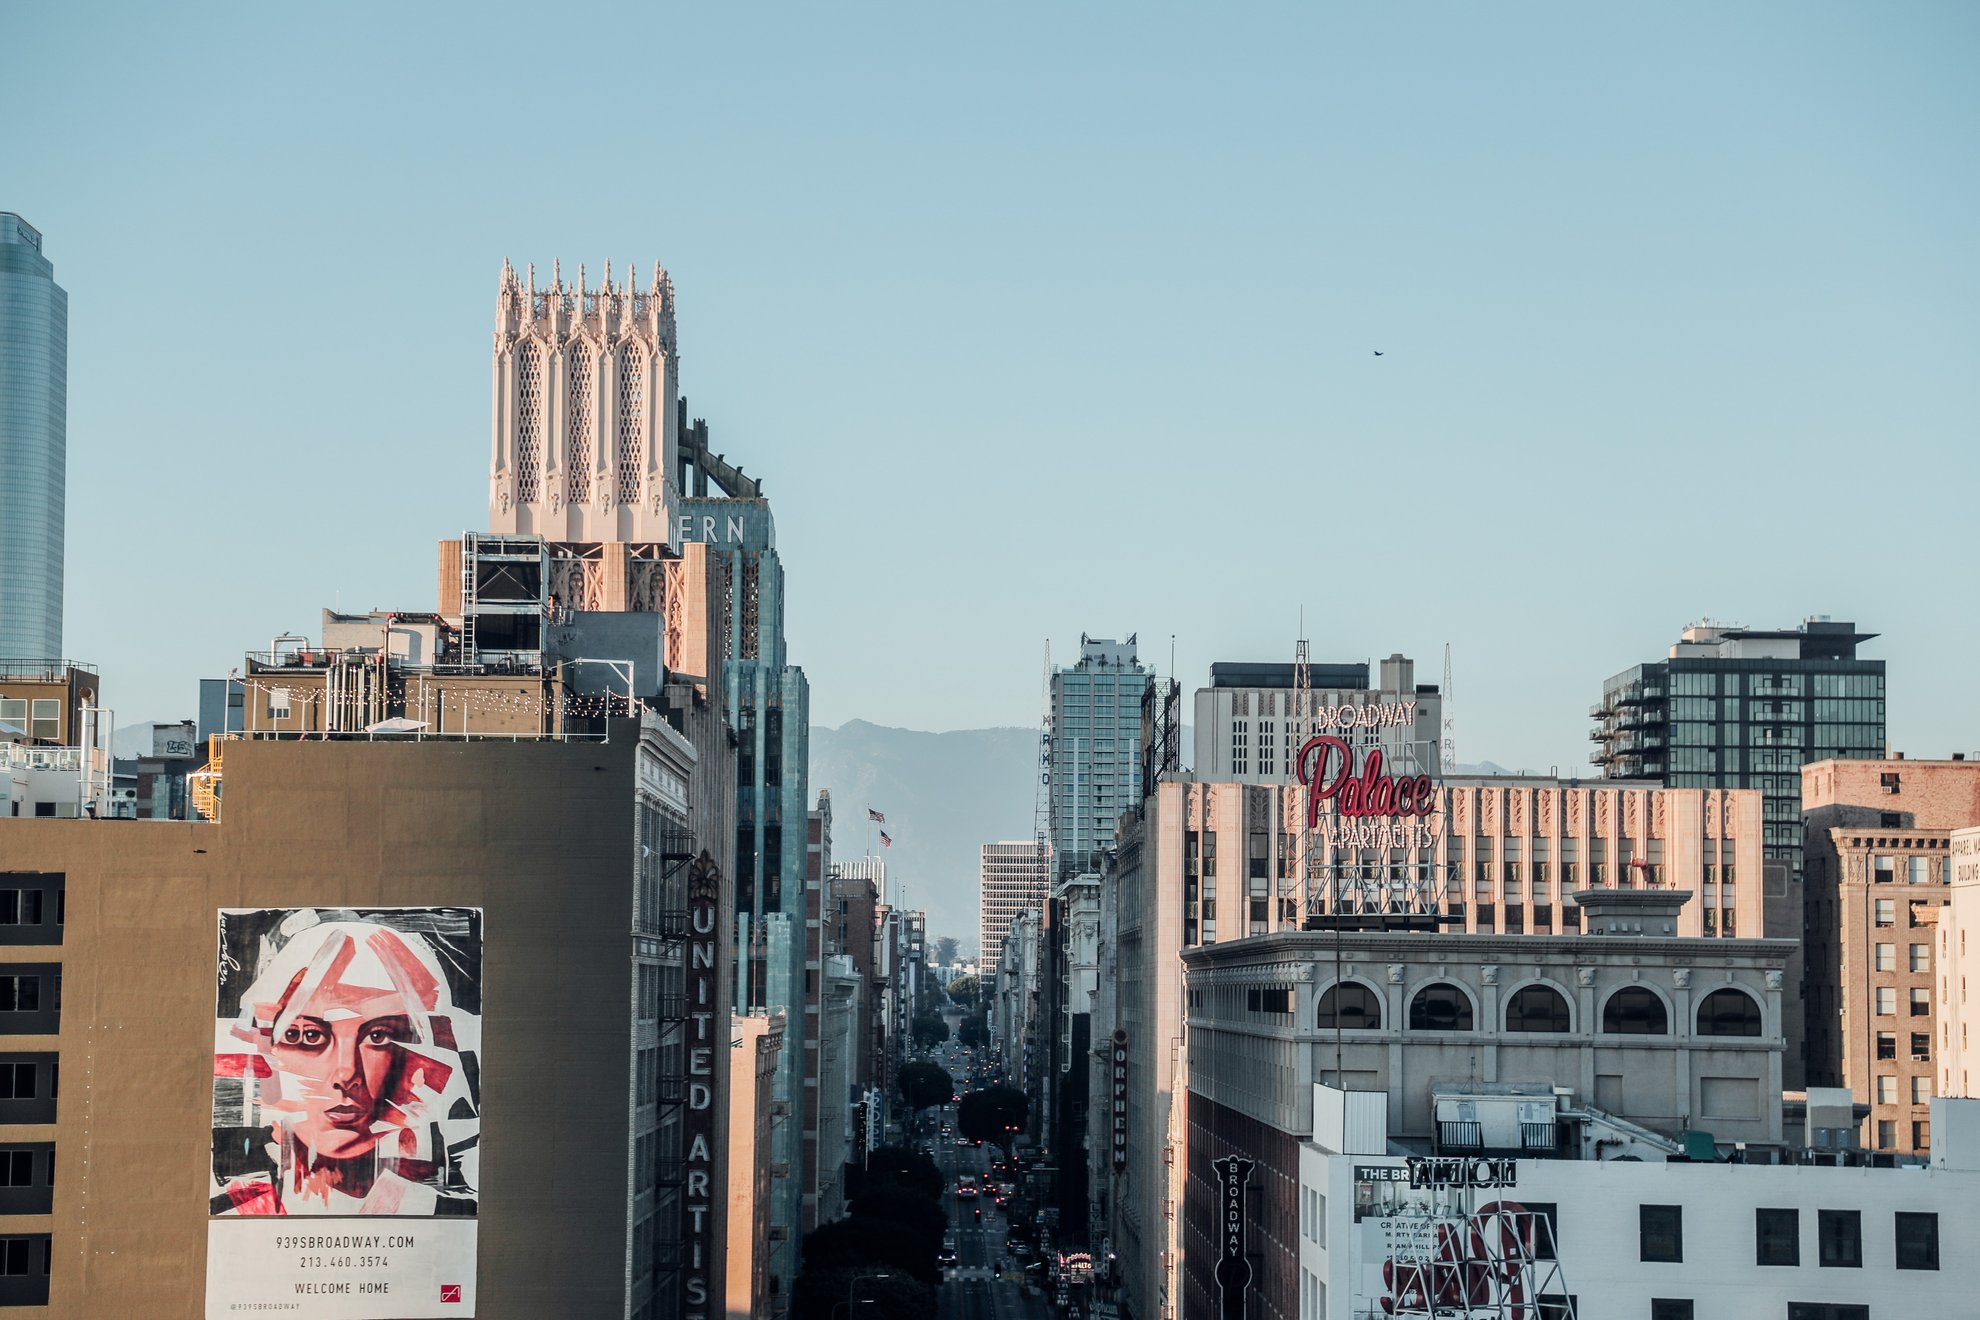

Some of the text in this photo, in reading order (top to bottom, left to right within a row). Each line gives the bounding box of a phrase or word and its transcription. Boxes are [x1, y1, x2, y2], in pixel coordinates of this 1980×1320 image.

[1318, 701, 1417, 729] BROADWAY
[1296, 735, 1435, 828] Palace
[1329, 822, 1434, 849] APARTMENTS
[686, 906, 715, 1320] UNITED ARTIS
[1114, 1049, 1125, 1163] ORPHEUM
[1361, 1168, 1388, 1180] THE
[1228, 1163, 1240, 1257] BROADWAY
[276, 1236, 414, 1249] 939SBROADWAY.COM
[300, 1256, 388, 1268] 213.460.3574
[294, 1282, 390, 1295] WELCOME HOME
[230, 1303, 300, 1311] @939SBROADWAY
